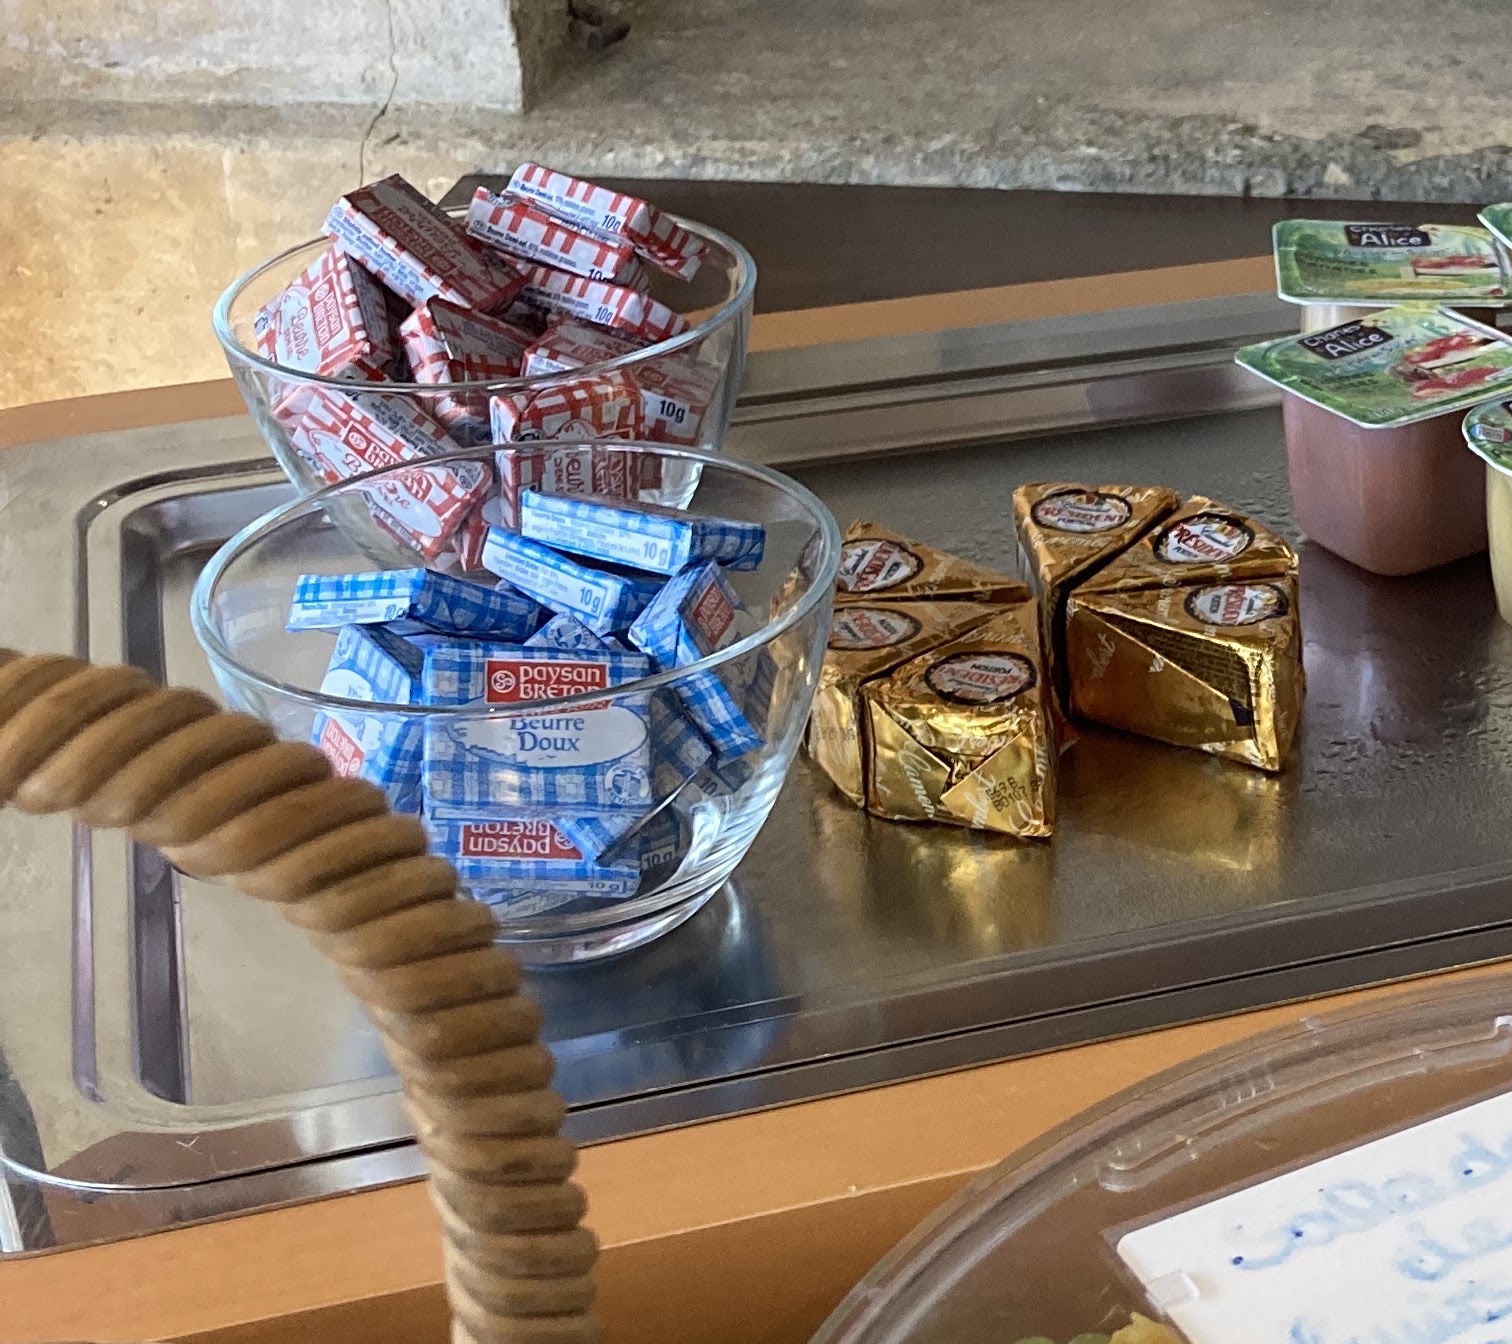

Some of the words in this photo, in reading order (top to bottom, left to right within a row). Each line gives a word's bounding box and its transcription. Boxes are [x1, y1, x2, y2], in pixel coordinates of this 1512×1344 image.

[603, 213, 623, 233] 10g
[1361, 232, 1423, 246] Alice
[1325, 333, 1384, 357] Alice
[659, 399, 688, 424] 10g
[518, 665, 601, 685] paysan
[510, 716, 586, 732] Beurre
[517, 730, 580, 752] Doux
[468, 835, 551, 855] paysan
